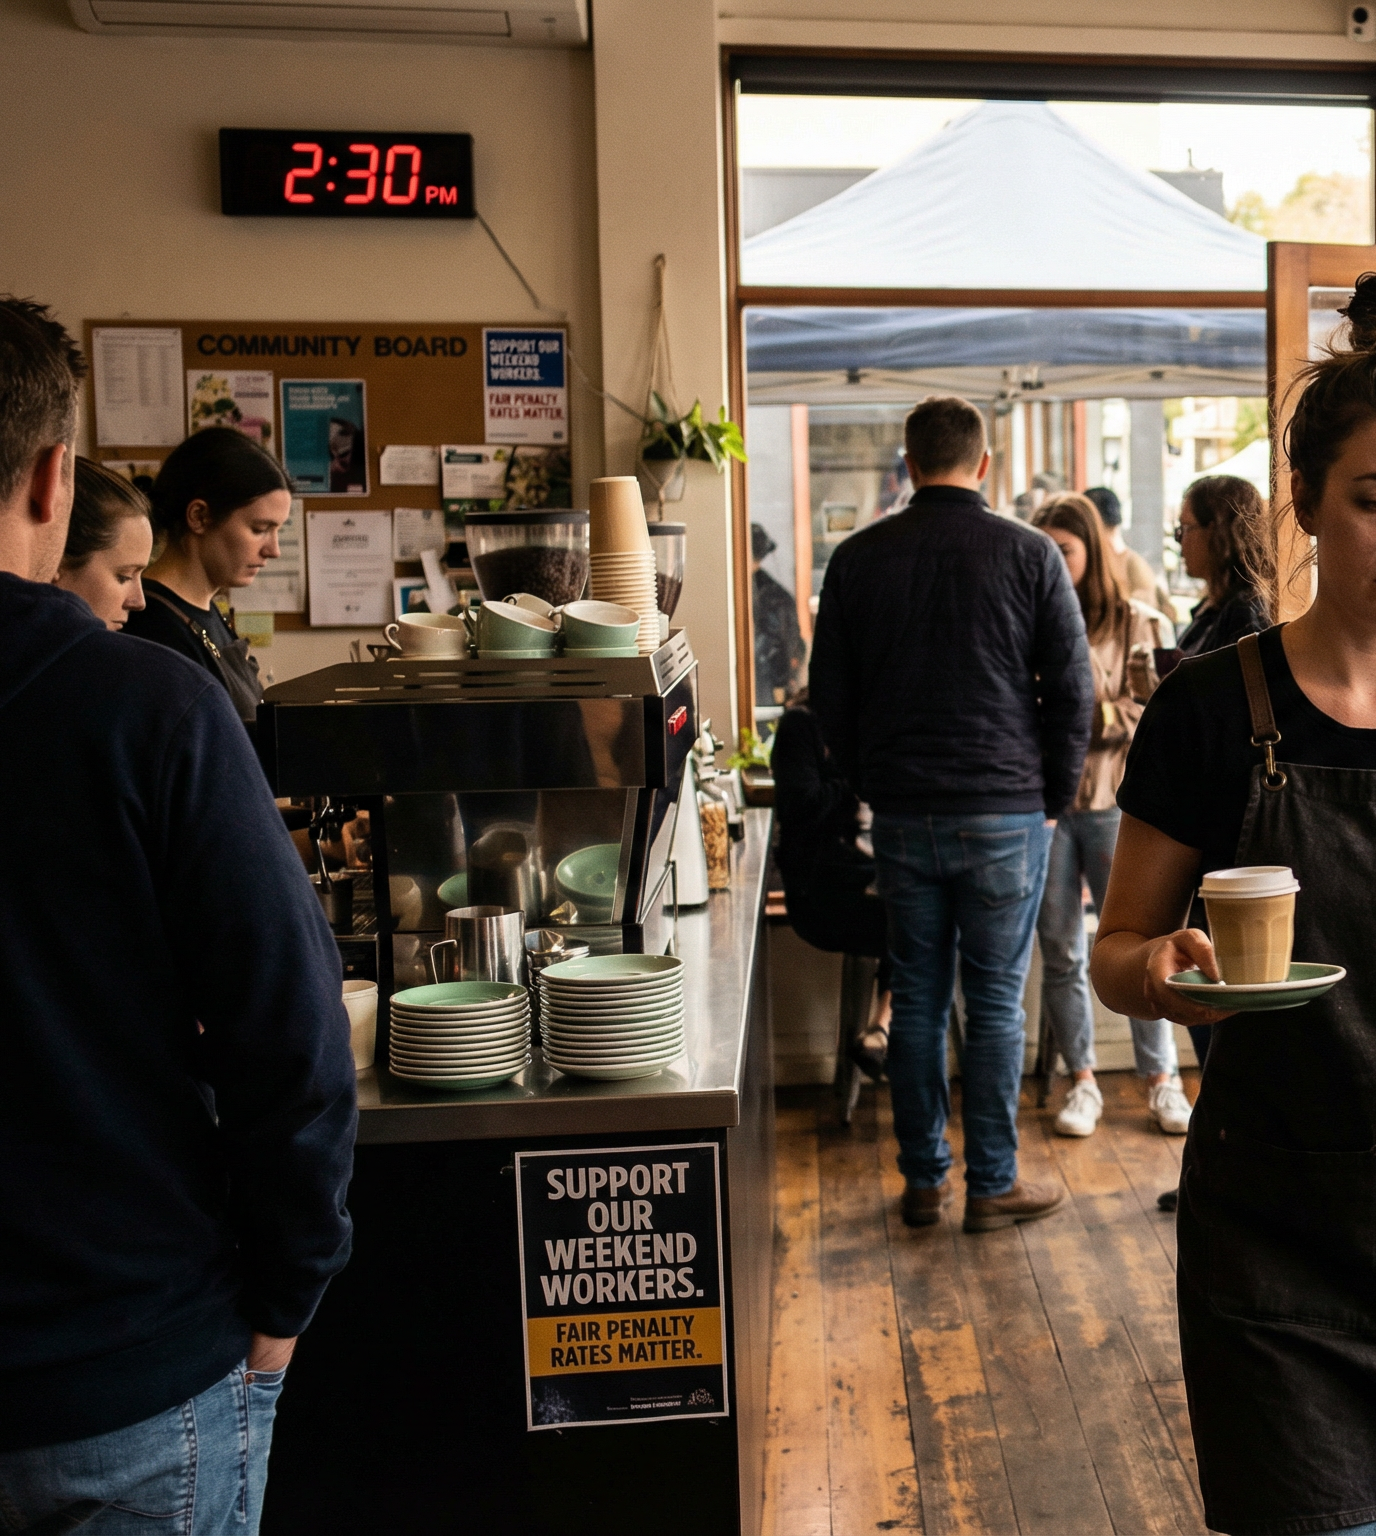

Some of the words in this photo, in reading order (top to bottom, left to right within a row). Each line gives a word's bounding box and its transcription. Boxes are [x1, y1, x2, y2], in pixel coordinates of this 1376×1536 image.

[284, 143, 422, 205] 2:30
[425, 185, 457, 205] PM
[197, 334, 362, 357] COMMUNITY
[373, 336, 468, 357] BOARD
[489, 393, 511, 405] FAIR
[514, 393, 558, 406] PENALTY
[489, 407, 520, 419] RATES
[547, 1162, 690, 1201] SUPPORT
[587, 1200, 654, 1233] OUR
[545, 1232, 697, 1271] WEEKEND
[540, 1267, 704, 1307] WORKERS.
[556, 1321, 601, 1343] FAIR
[607, 1315, 695, 1340] PENALTY
[551, 1344, 612, 1367] RATES
[618, 1339, 703, 1363] MATTER.
